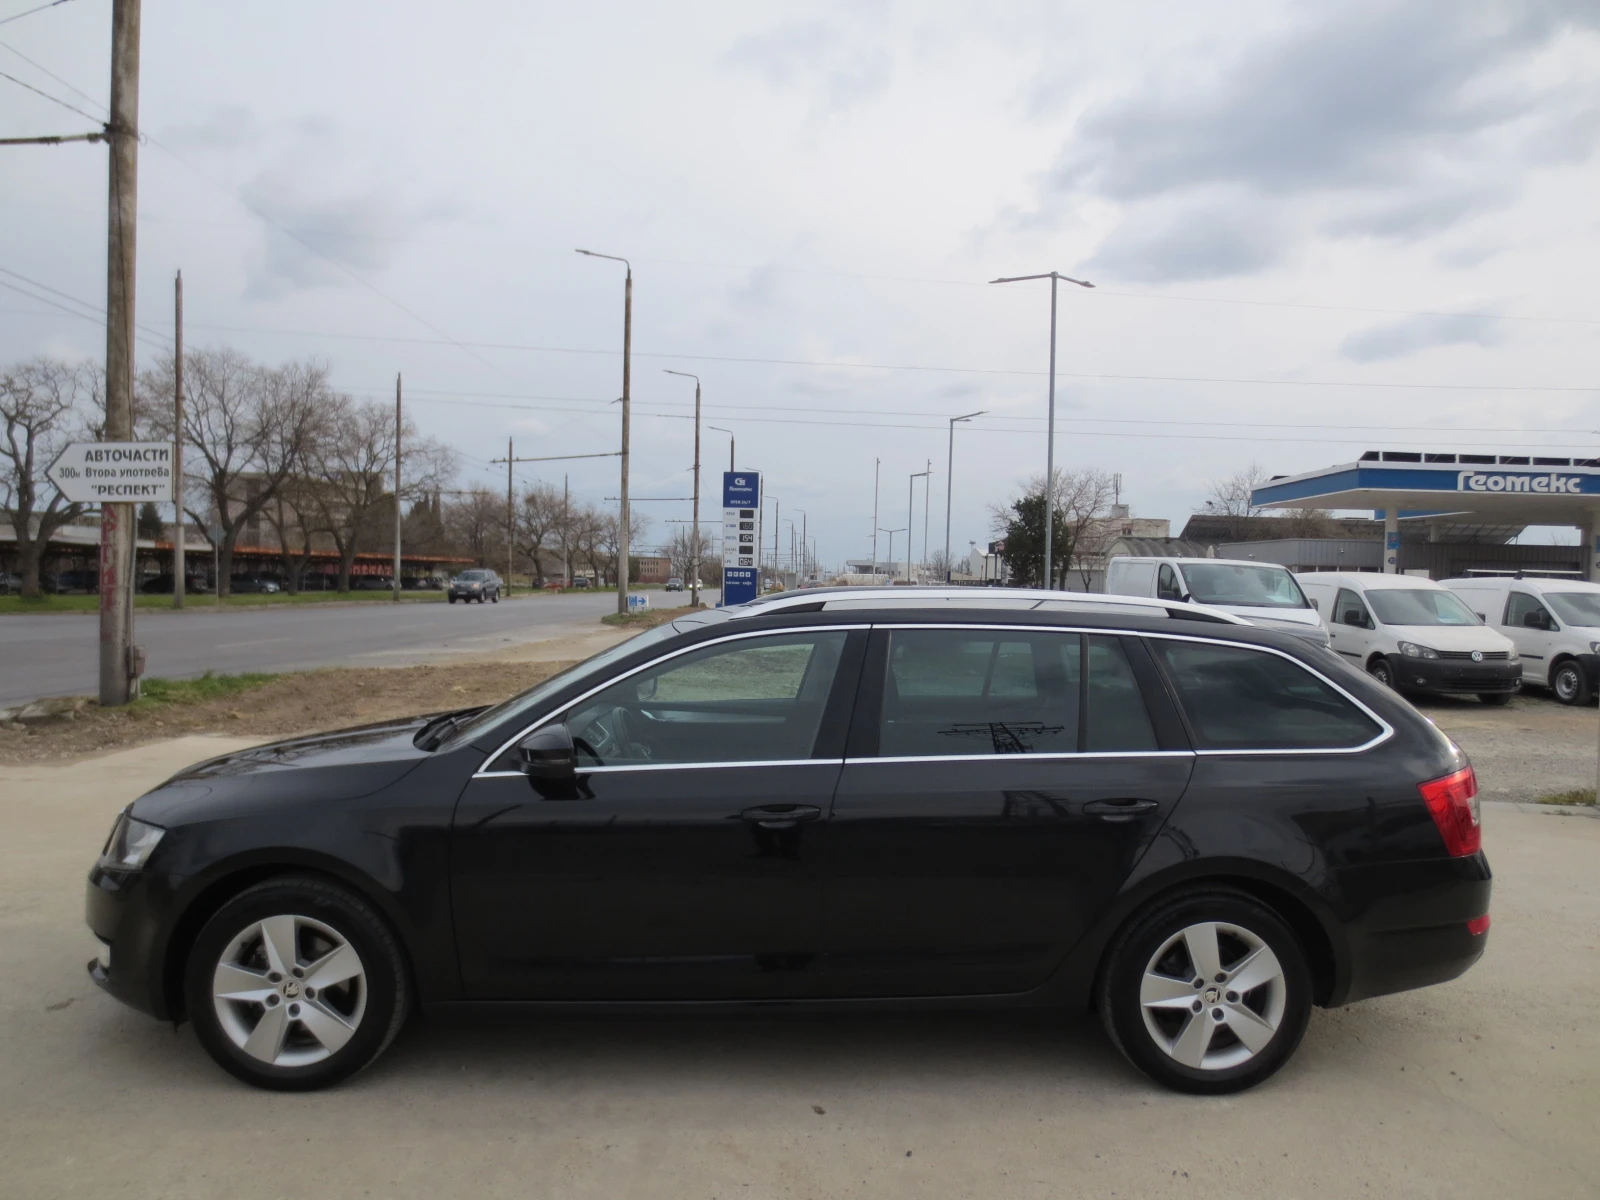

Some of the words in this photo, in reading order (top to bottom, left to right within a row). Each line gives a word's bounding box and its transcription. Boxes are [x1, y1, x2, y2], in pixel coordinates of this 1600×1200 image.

[85, 449, 169, 462] АВТОЧАСТИ
[85, 467, 117, 479] Втора
[120, 467, 170, 479] употреба
[1457, 471, 1581, 493] Геомекс
[91, 484, 165, 496] "РЕСПЕКТ"
